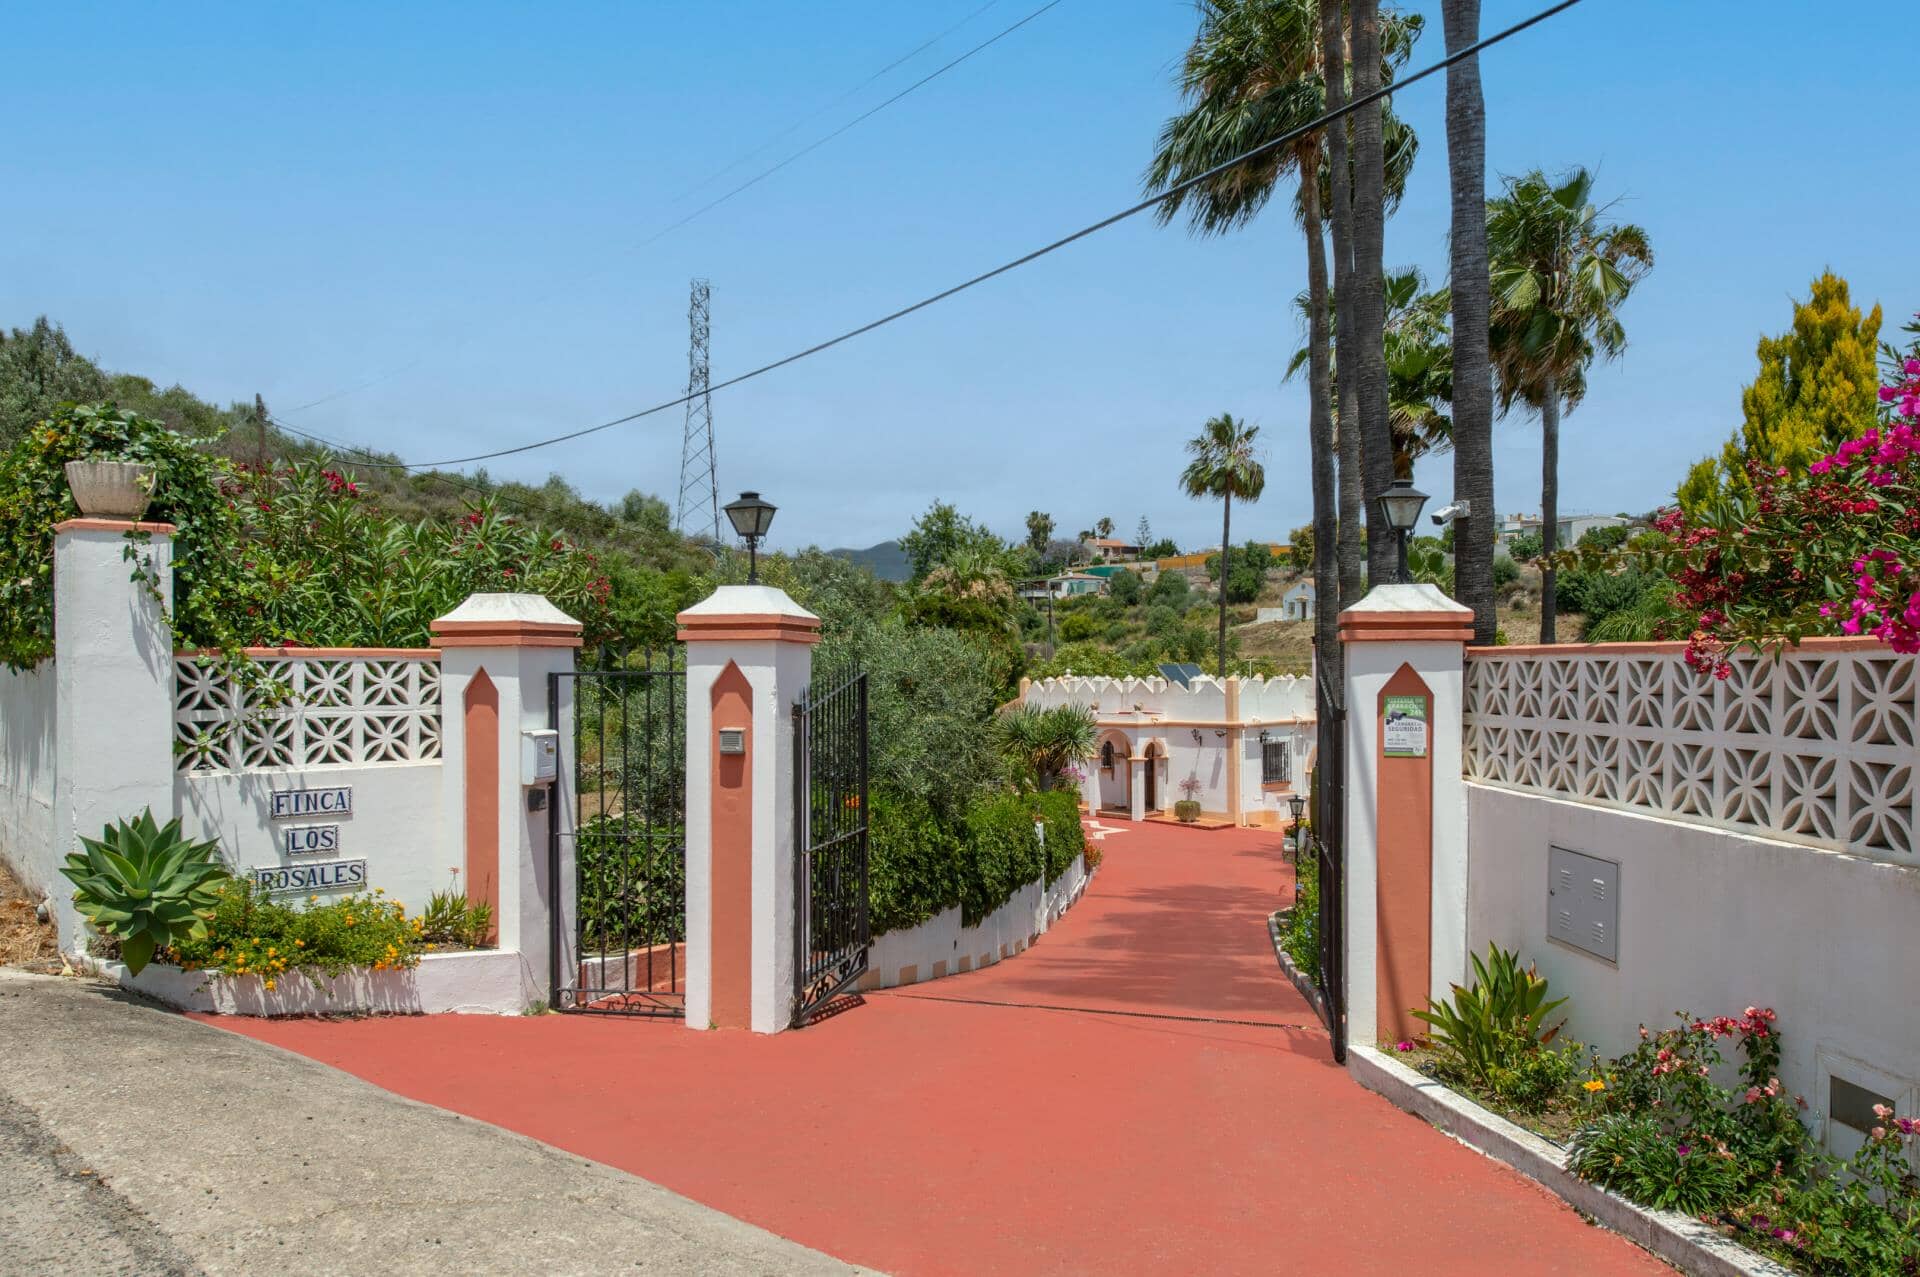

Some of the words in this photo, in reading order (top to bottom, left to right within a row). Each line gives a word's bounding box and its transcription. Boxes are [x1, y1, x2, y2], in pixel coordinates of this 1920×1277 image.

[275, 791, 347, 814] FINCA
[291, 830, 335, 850] LOS
[261, 864, 362, 889] ROSALES
